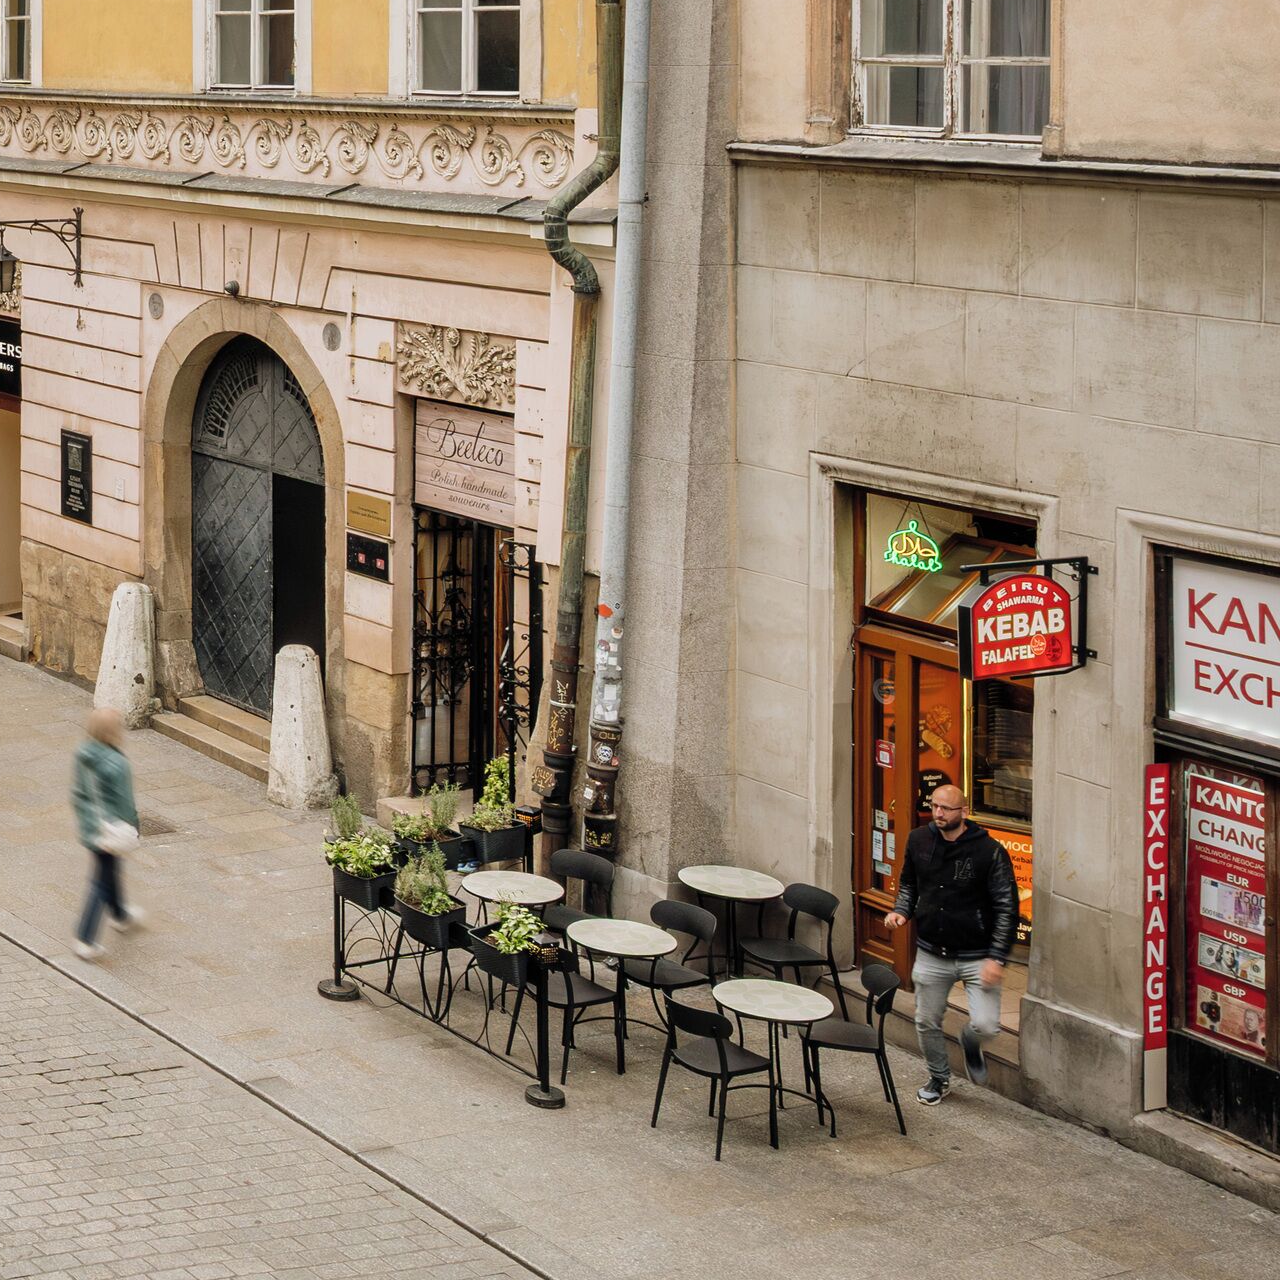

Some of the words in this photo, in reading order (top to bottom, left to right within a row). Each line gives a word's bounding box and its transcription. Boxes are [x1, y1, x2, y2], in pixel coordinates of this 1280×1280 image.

[0, 362, 14, 372] BAGS
[430, 469, 460, 487] Polish
[461, 476, 509, 500] handmade
[448, 494, 490, 512] souvenirs
[982, 581, 1063, 612] BEIRUT
[996, 594, 1045, 612] SHAWARMA
[976, 607, 1067, 644] KEBAB
[1187, 587, 1280, 645] KAN
[981, 644, 1036, 666] FALAFEL
[1197, 819, 1265, 853] CHANG
[1226, 872, 1249, 888] EUR
[1146, 776, 1166, 1035] EXCHANGE
[1223, 929, 1248, 945] USD
[1223, 983, 1246, 998] GBP
